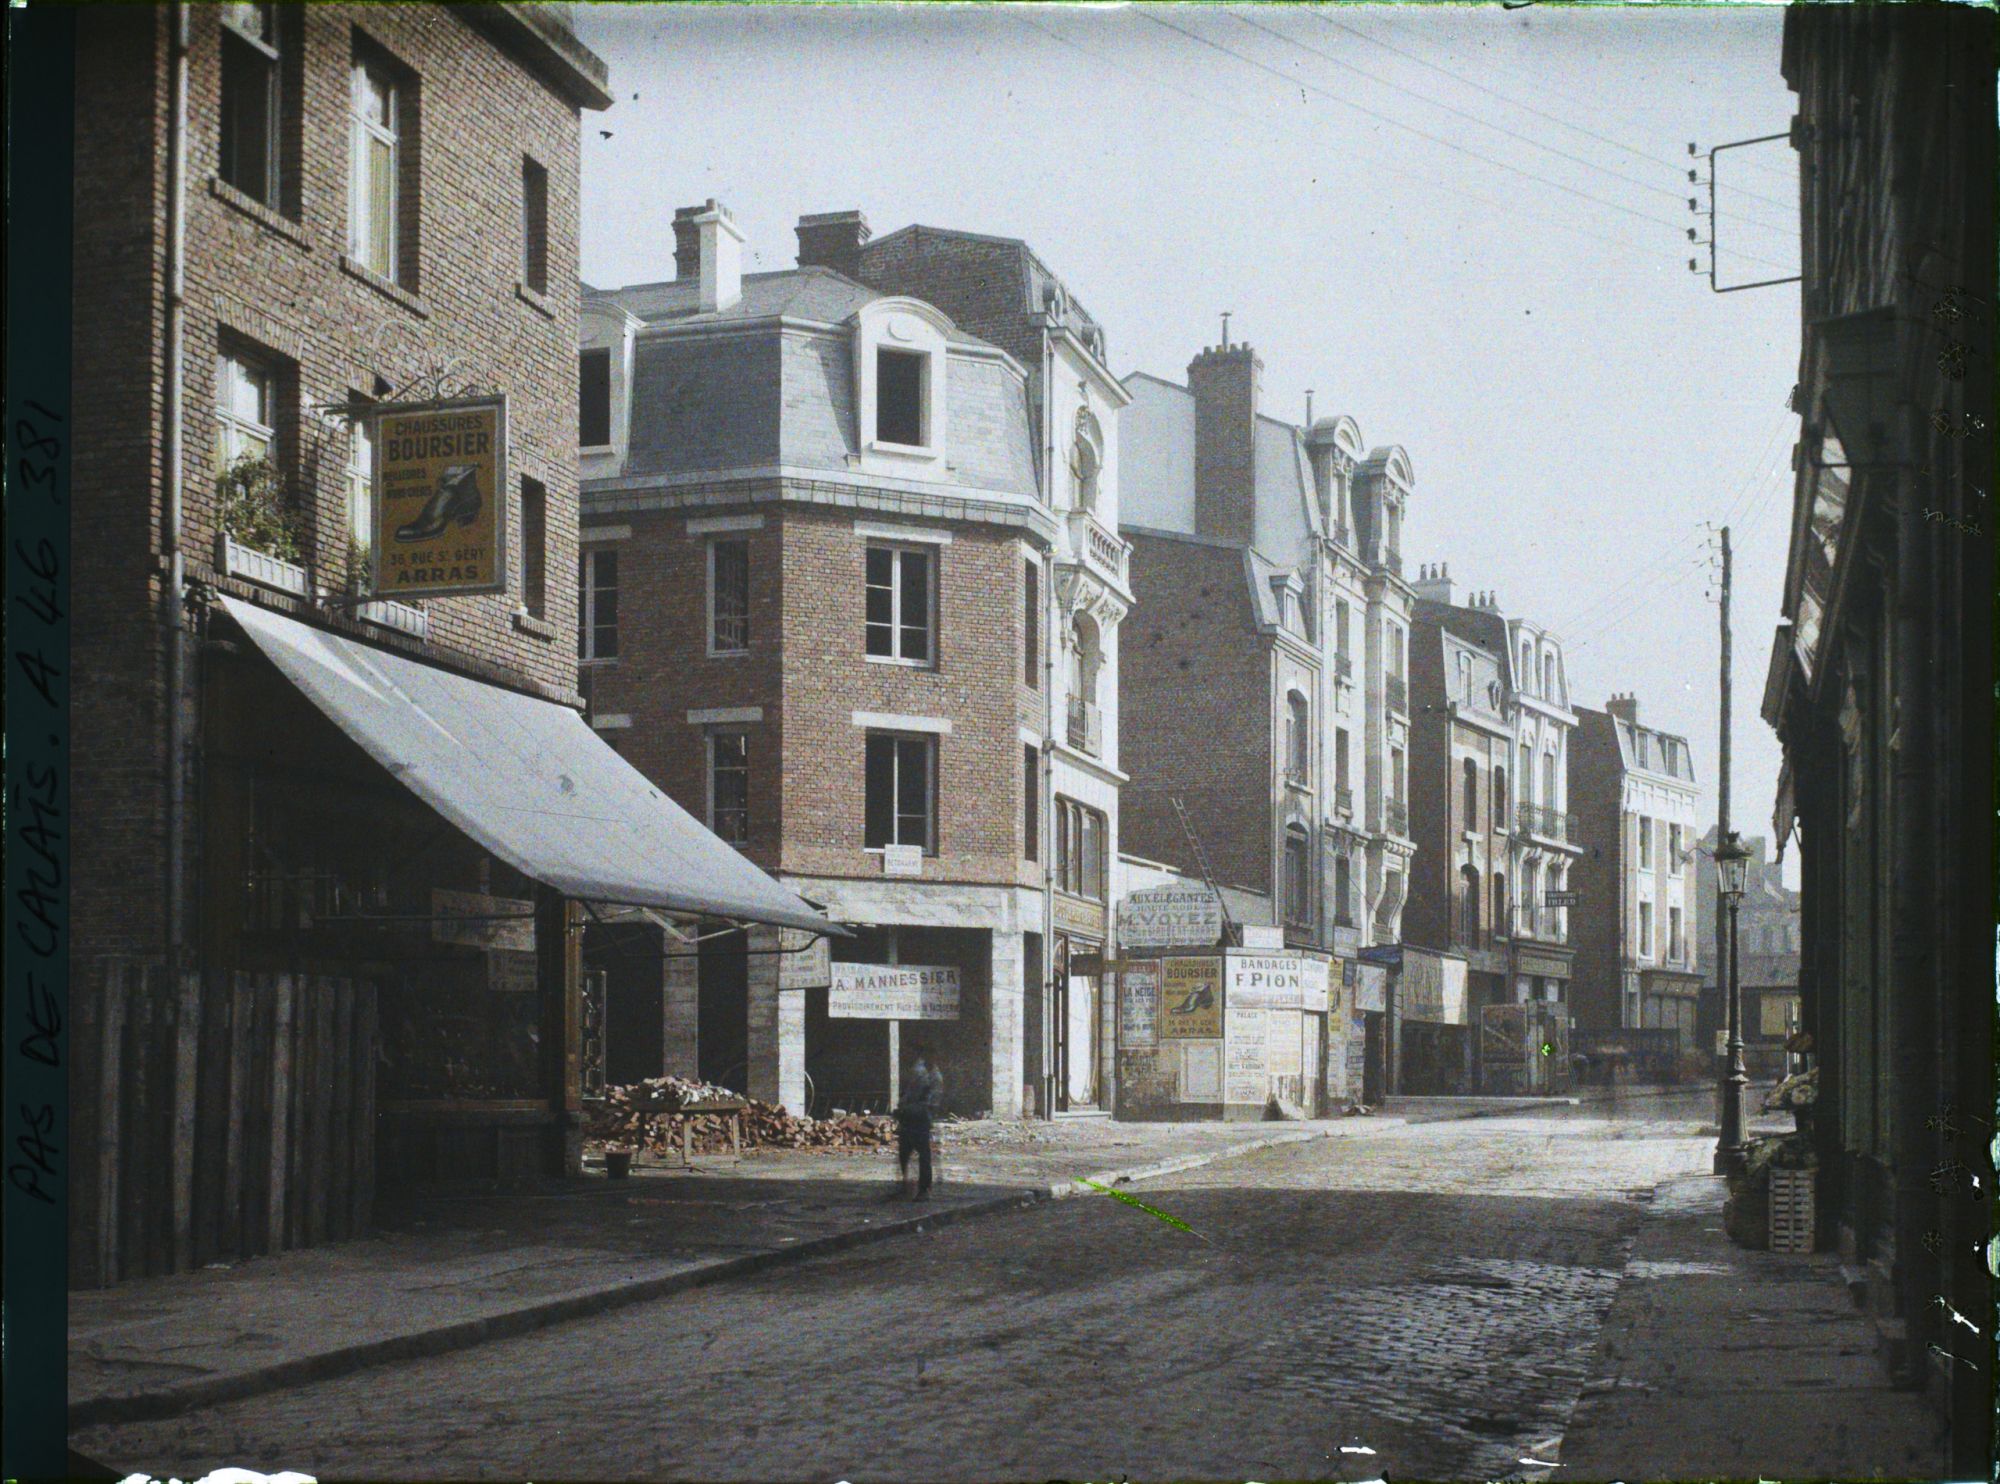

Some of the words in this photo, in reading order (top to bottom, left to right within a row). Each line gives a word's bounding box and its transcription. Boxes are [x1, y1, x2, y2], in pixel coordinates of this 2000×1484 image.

[395, 415, 483, 436] CHAUSSURES
[15, 399, 64, 505] 381
[388, 432, 488, 461] BOURSIER
[411, 550, 434, 565] RUE
[15, 536, 65, 626] 46
[397, 564, 478, 584] ARRAS
[15, 647, 62, 709] A
[1138, 912, 1217, 925] VOYEZ
[1166, 967, 1218, 979] BOURSIER
[1240, 958, 1298, 970] BANDAGES
[854, 969, 957, 990] MANNESSIER
[1250, 972, 1299, 988] PION
[19, 970, 61, 1068] DE
[8, 1102, 60, 1205] PAS
